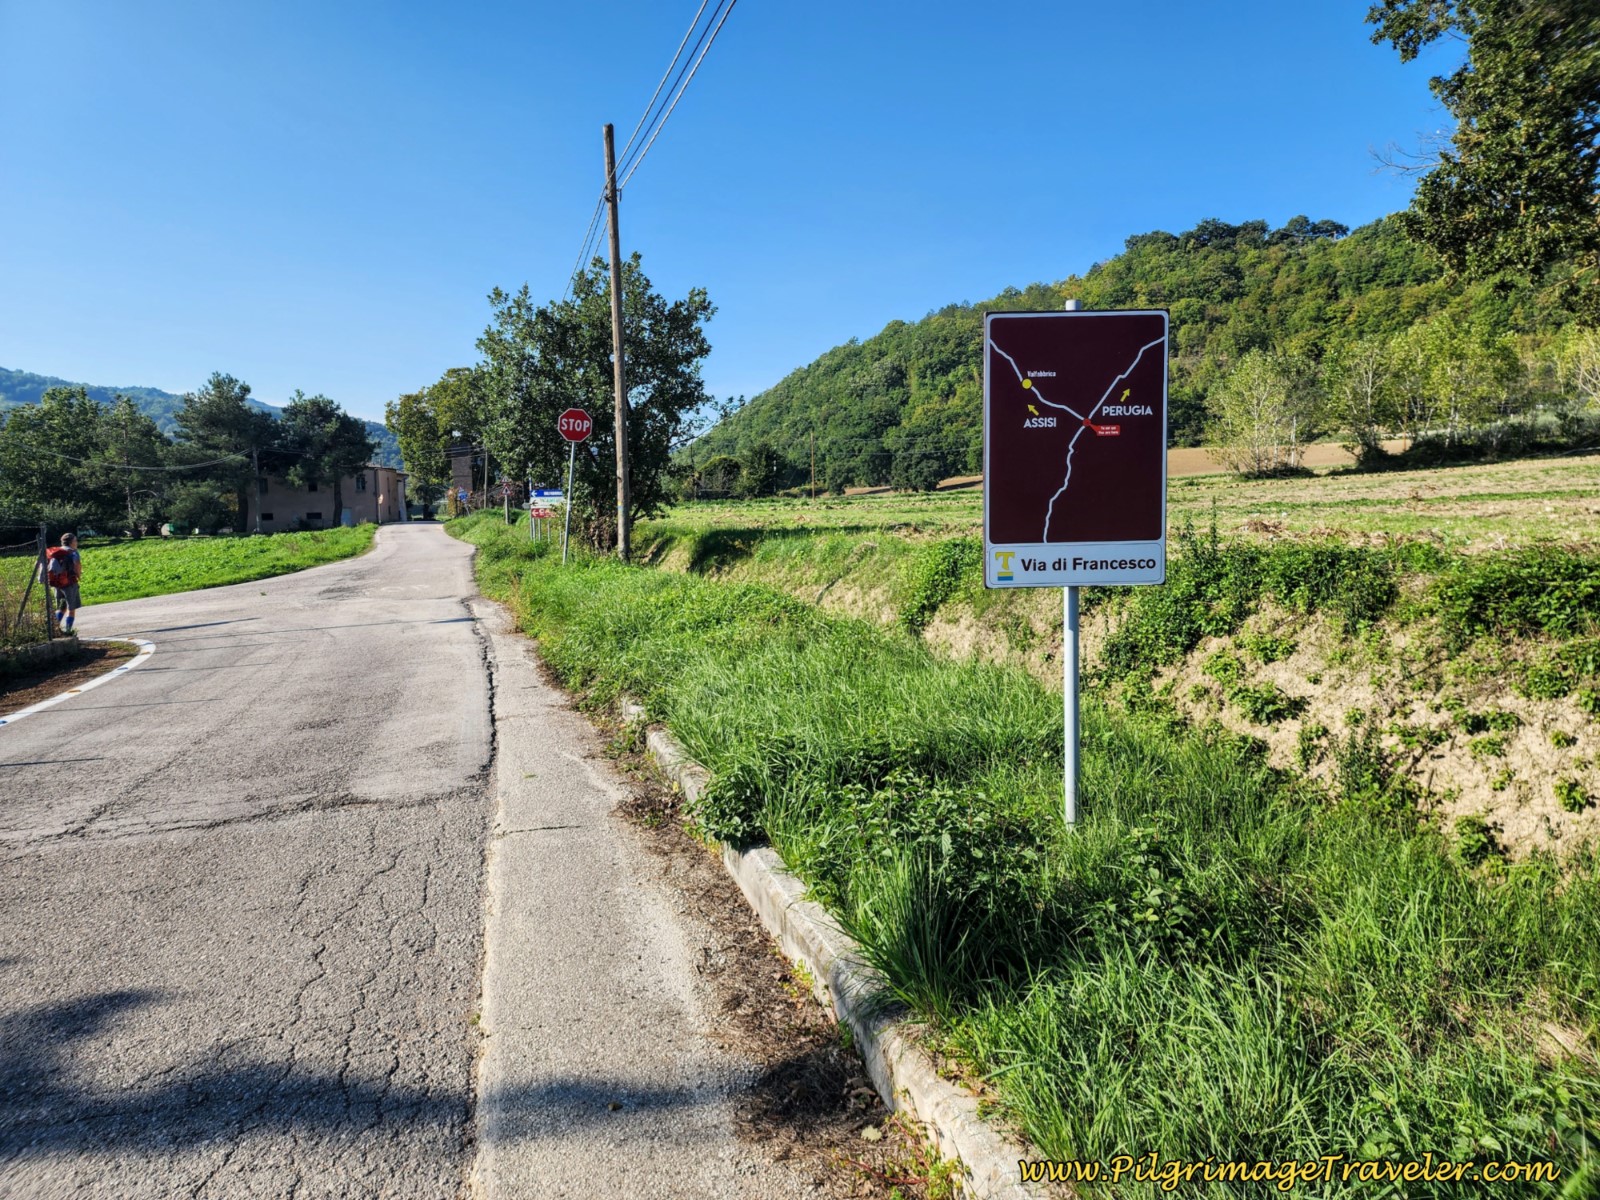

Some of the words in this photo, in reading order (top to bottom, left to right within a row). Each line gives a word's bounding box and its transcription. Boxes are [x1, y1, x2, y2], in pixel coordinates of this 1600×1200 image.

[1102, 405, 1153, 416] PERUGIA
[561, 418, 590, 432] STOP
[1023, 417, 1057, 428] ASSISI
[1021, 557, 1047, 571] Via
[1052, 556, 1067, 570] di
[1073, 556, 1157, 571] Francesco
